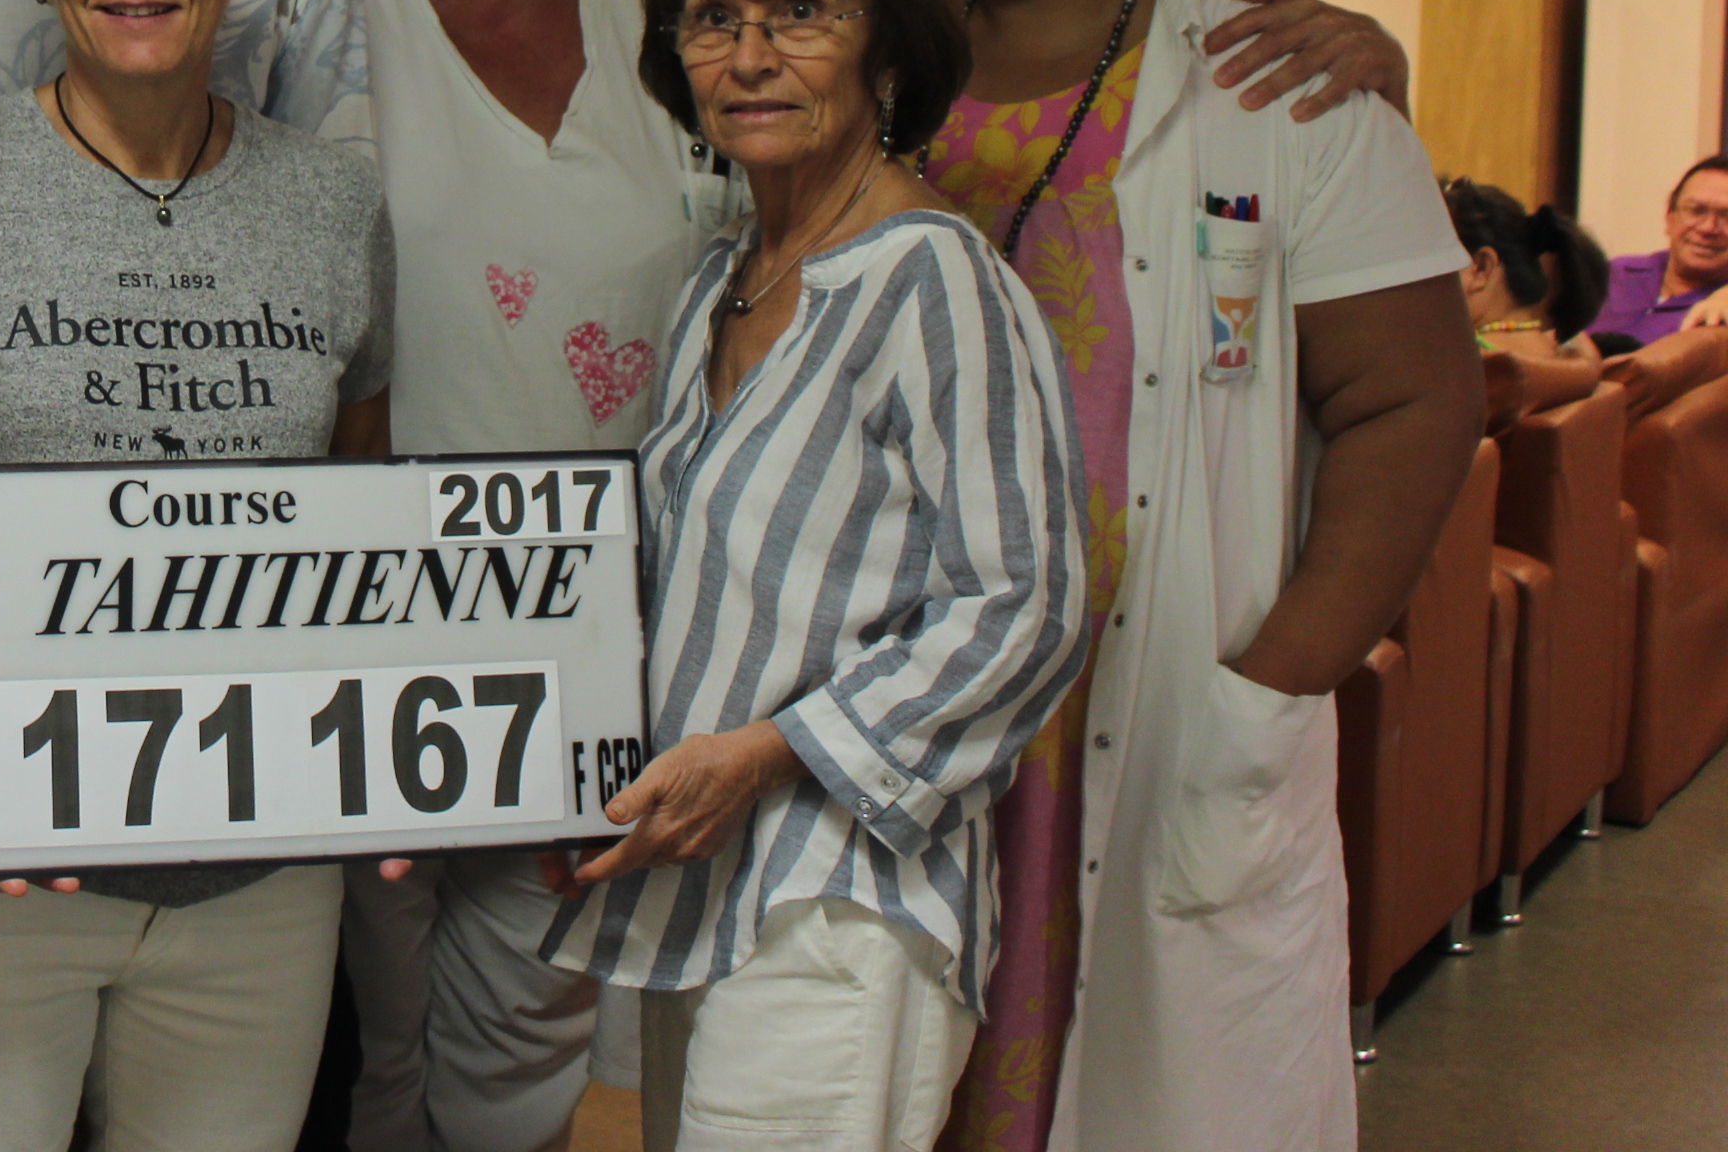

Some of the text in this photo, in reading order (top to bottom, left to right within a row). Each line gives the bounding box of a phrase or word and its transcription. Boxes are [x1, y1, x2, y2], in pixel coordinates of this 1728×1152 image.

[118, 273, 216, 290] EST. 1892
[1, 298, 326, 356] Abercrombie
[84, 359, 275, 413] & Fitch
[94, 432, 264, 453] NEW YORK
[108, 469, 613, 538] Course 2017
[36, 543, 592, 638] TAHITIENNE
[22, 684, 255, 831] 171
[309, 673, 547, 818] 167
[572, 741, 586, 815] F
